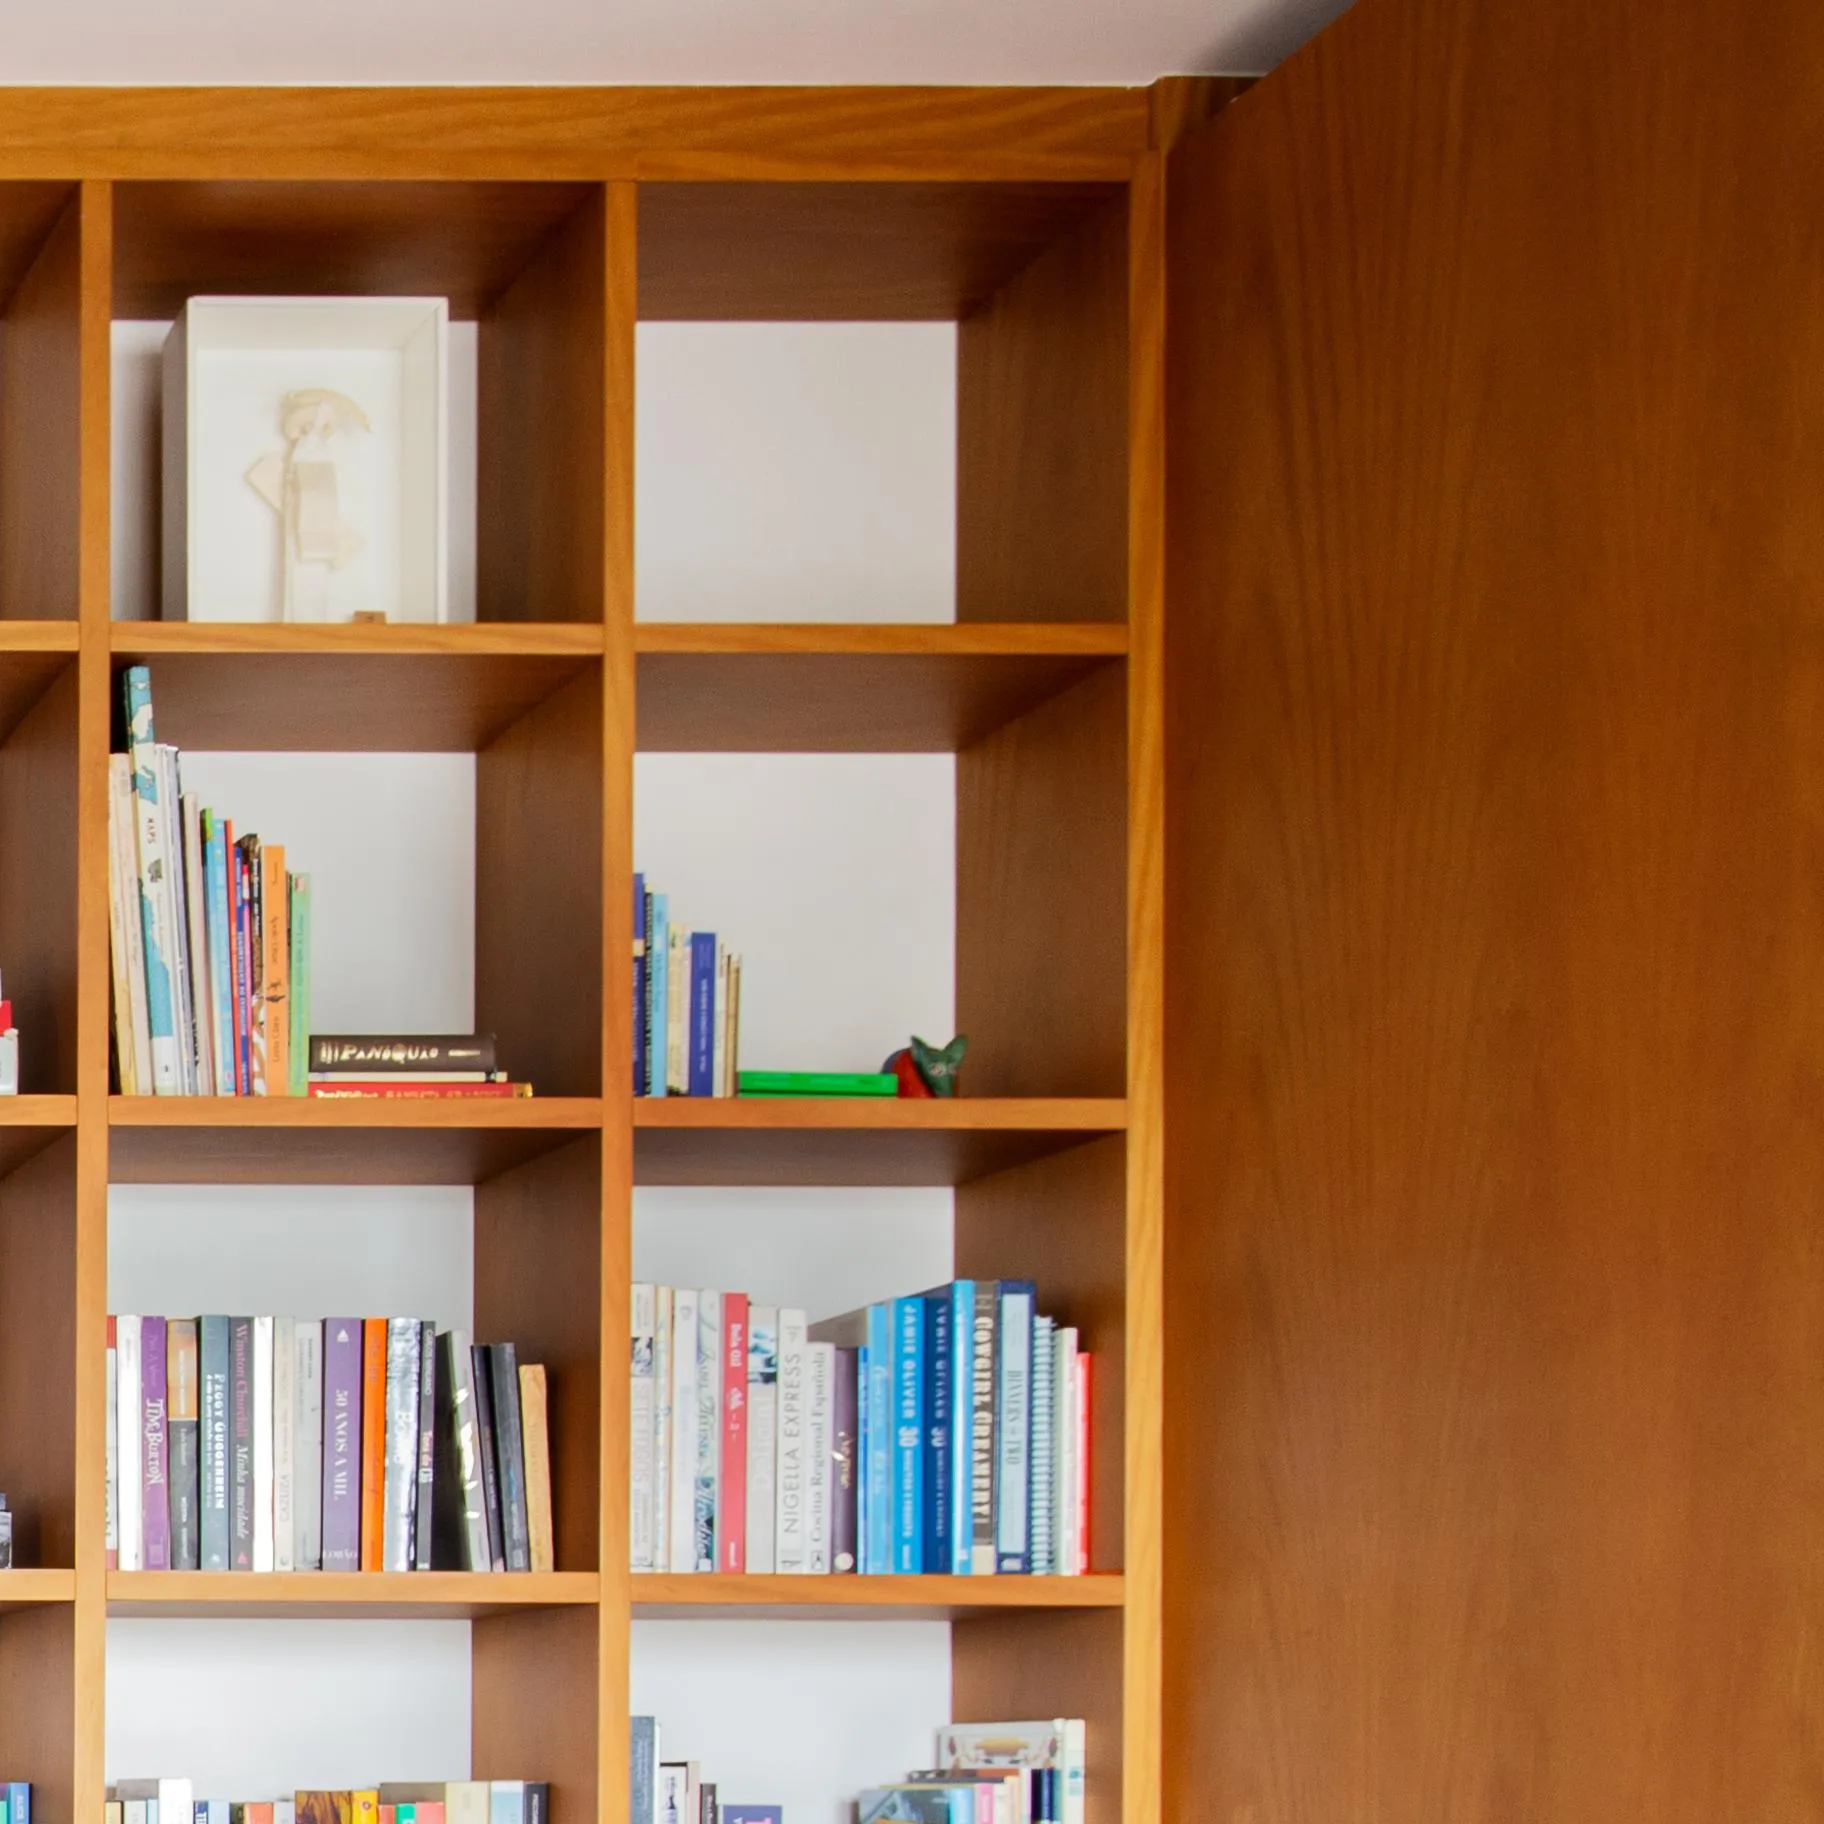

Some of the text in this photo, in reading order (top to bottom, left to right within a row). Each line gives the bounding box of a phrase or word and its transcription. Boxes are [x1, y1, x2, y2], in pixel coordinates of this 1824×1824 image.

[236, 1324, 248, 1437] Winston Churchill
[903, 1305, 915, 1418] JAMIE OLIVER
[973, 1317, 994, 1517] COWGIRL CREAMERY
[145, 1398, 165, 1484] TIM BURTON
[214, 1374, 225, 1509] PEGGY GUGGENHEIM
[333, 1388, 349, 1500] 50 ANOS A MIL
[633, 1384, 650, 1483] SETE FOGOS
[783, 1353, 799, 1534] NIGELLA EXPRESS
[811, 1352, 826, 1542] Cocina Regional Española
[899, 1426, 919, 1447] 30
[236, 1444, 249, 1539] Minha mocidade
[16, 1795, 25, 1819] ALICE
